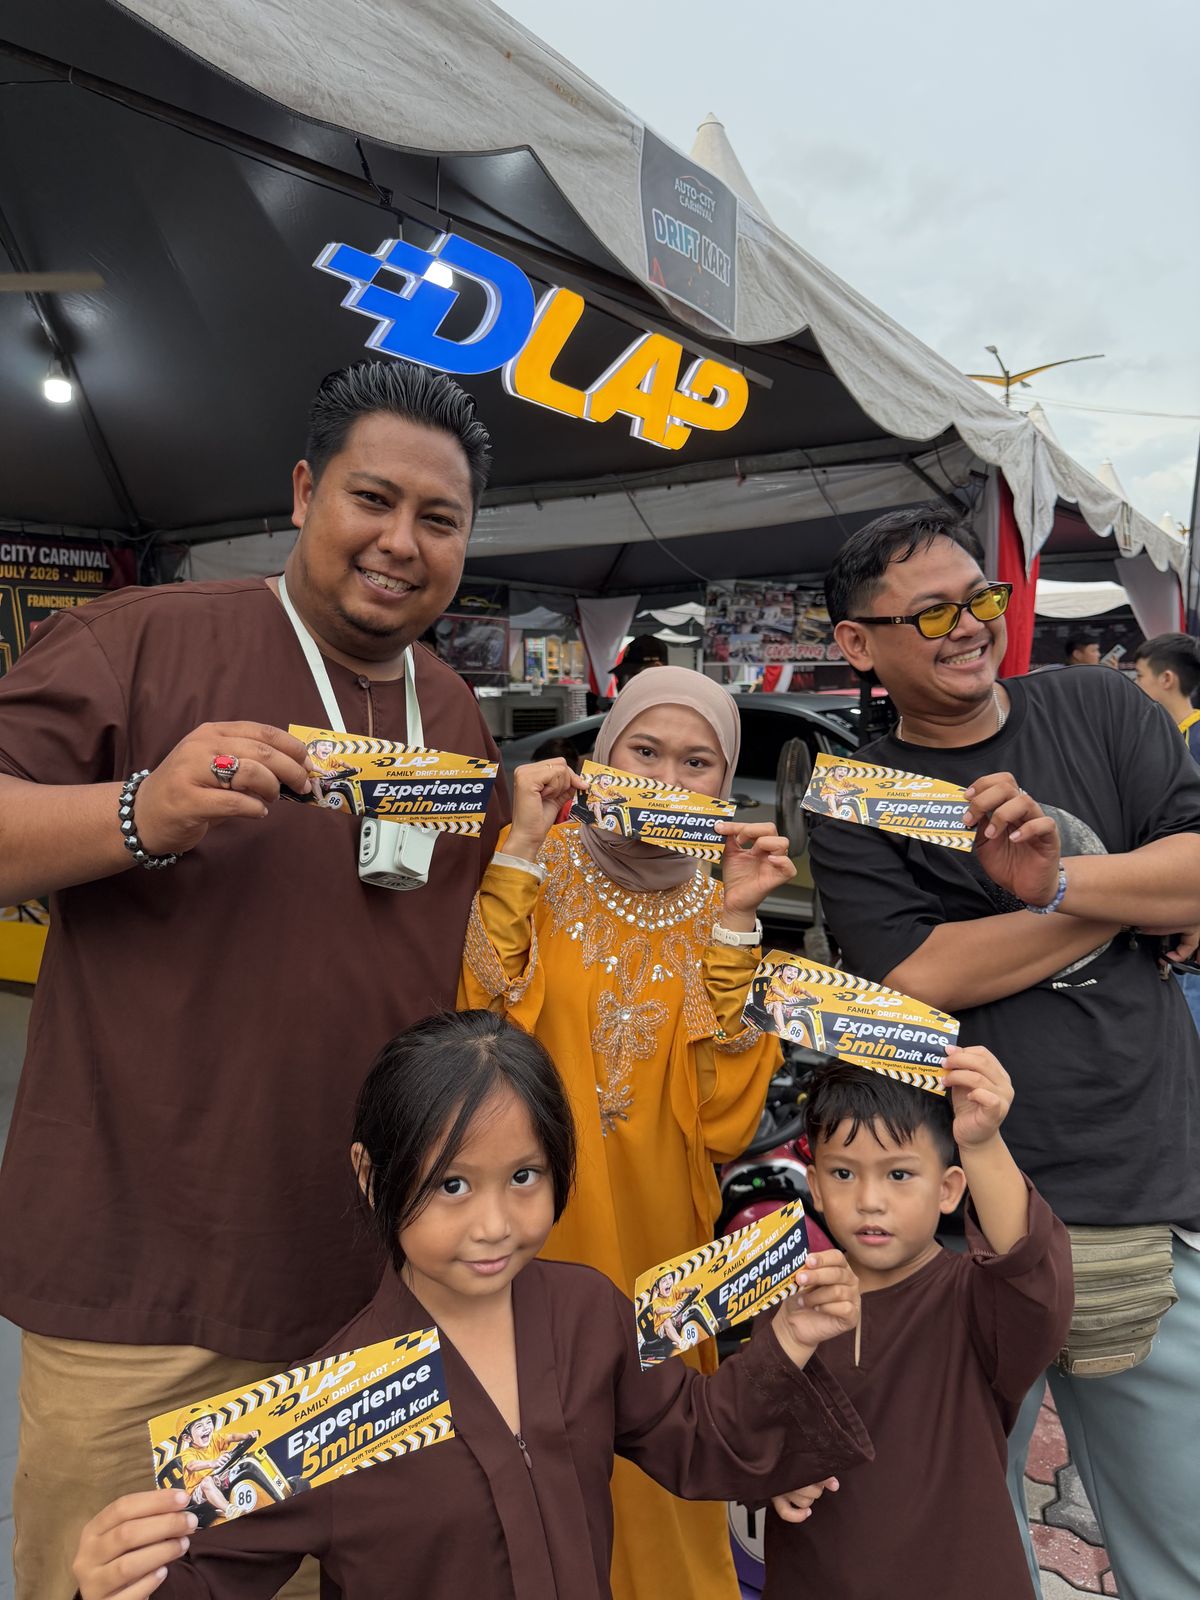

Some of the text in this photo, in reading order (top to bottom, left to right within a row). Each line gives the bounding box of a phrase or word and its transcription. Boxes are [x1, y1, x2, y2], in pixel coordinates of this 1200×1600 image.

[674, 178, 716, 212] AUTO-CITY
[652, 208, 731, 287] DRIFT KART
[312, 233, 748, 450] DLAP
[39, 546, 110, 568] CARNIVAL
[30, 566, 60, 580] 2026
[72, 570, 104, 583] JURU
[27, 594, 75, 608] FRANCHISE
[371, 756, 440, 768] DLAP
[328, 796, 340, 807] 86
[372, 780, 484, 800] Experience
[374, 796, 482, 813] 5min Drift Kart
[638, 822, 722, 842] 5min Drift Kart
[877, 812, 926, 826] 5min
[926, 820, 948, 828] Drift
[846, 1006, 923, 1022] FAMILY DRIFT KART
[790, 1026, 802, 1038] 86
[832, 1016, 949, 1046] Experience
[834, 1033, 948, 1064] 5min Drift Kar
[718, 1228, 802, 1306] Experience
[723, 1230, 780, 1278] FAMILY DRIFT KART
[726, 1275, 772, 1320] 5min
[771, 1264, 792, 1286] Drift
[686, 1328, 696, 1340] 86
[268, 1360, 356, 1418] DLAP
[294, 1363, 389, 1422] FAMILY DRIFT KART
[288, 1364, 432, 1460] Experience
[302, 1388, 440, 1479] 5min Drift Kart
[352, 1412, 434, 1463] Drift Together, Laugh Together!
[238, 1490, 252, 1506] 86
